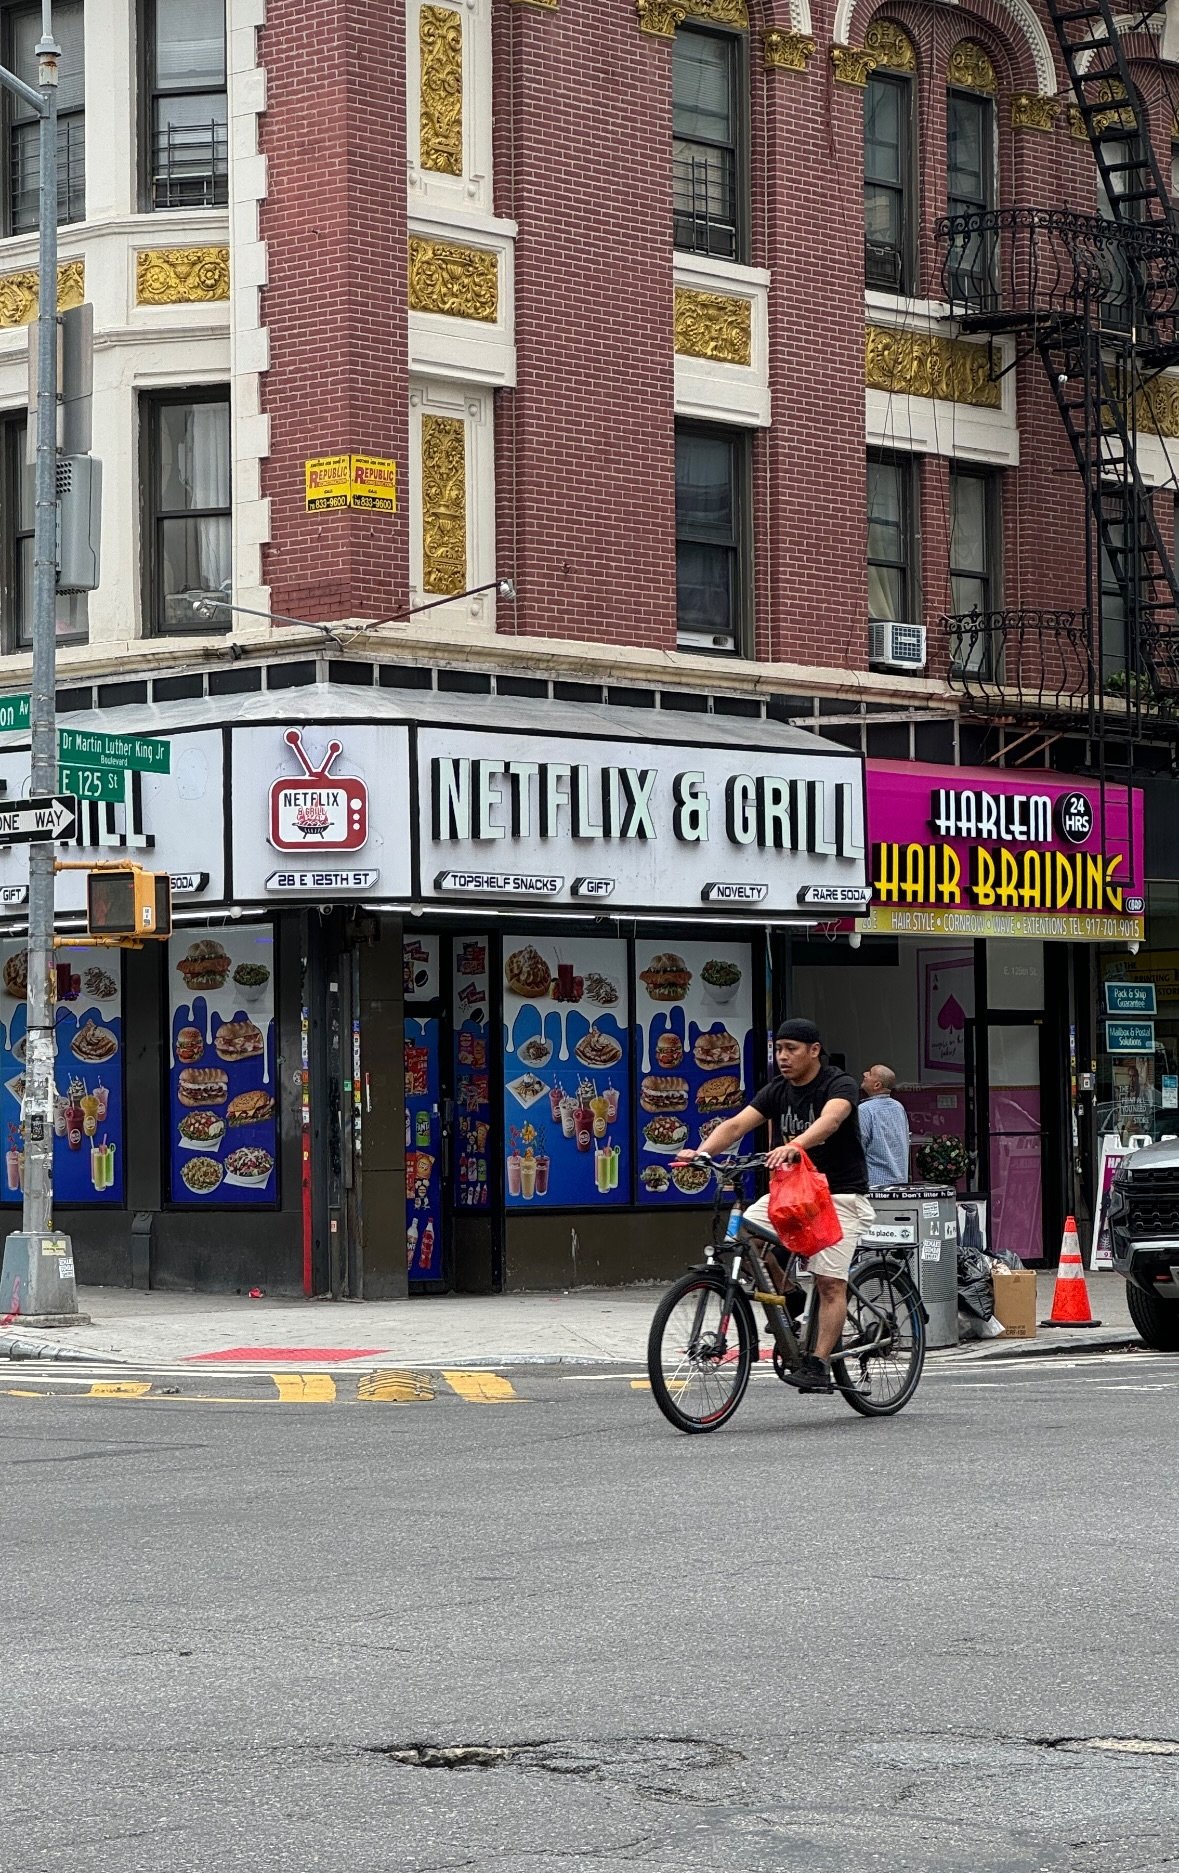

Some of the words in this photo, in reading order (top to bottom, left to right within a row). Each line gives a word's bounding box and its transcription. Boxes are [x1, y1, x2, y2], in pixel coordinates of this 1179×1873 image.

[309, 466, 347, 488] REPUBLIC
[354, 466, 394, 484] REPUBLIC
[316, 496, 346, 509] 833-9600
[360, 496, 392, 509] 833-9600
[19, 700, 29, 716] Av
[62, 732, 72, 749] Dr
[76, 734, 102, 753] Martin
[105, 740, 132, 756] Luther
[135, 743, 153, 762] King
[155, 744, 165, 760] Jr
[100, 755, 128, 767] Boulevard
[62, 770, 70, 793] E
[78, 771, 102, 796] 125
[108, 773, 118, 789] St
[284, 791, 339, 807] NETFLIX
[1070, 797, 1085, 813] 24
[305, 807, 327, 816] GRILL
[432, 757, 658, 841] NETFLIX
[674, 771, 710, 842] &
[726, 773, 864, 860] GRILL
[933, 788, 1052, 842] HARLEM
[35, 810, 63, 828] WAY
[1065, 815, 1090, 832] HRS
[170, 876, 194, 890] SODA
[278, 874, 295, 887] 28
[299, 874, 308, 886] E
[312, 873, 349, 886] 125TH
[353, 873, 370, 885] ST
[451, 874, 510, 889] TOPSHELF
[513, 877, 557, 891] SNACKS
[874, 842, 961, 904] HAIR
[972, 845, 1122, 912] BRAIDING
[587, 881, 610, 893] GIFT
[717, 885, 763, 898] NOVELTY
[2, 888, 22, 901] GIFT
[812, 888, 839, 900] RARE
[841, 889, 866, 901] SODA
[891, 911, 911, 930] HAIR
[912, 912, 935, 931] STYLE
[943, 913, 985, 932] CORNROW
[992, 914, 1015, 934] WAVE
[1086, 918, 1139, 938] 917-701-9015
[1114, 988, 1128, 998] Pack
[1128, 988, 1134, 998] &
[1134, 988, 1147, 1000] Ship
[1117, 998, 1145, 1008] Guarantee
[1110, 1027, 1129, 1037] Mailbox
[1130, 1027, 1135, 1037] &
[1135, 1027, 1151, 1037] Postal
[1119, 1037, 1142, 1046] Solutions
[876, 1229, 897, 1238] place.
